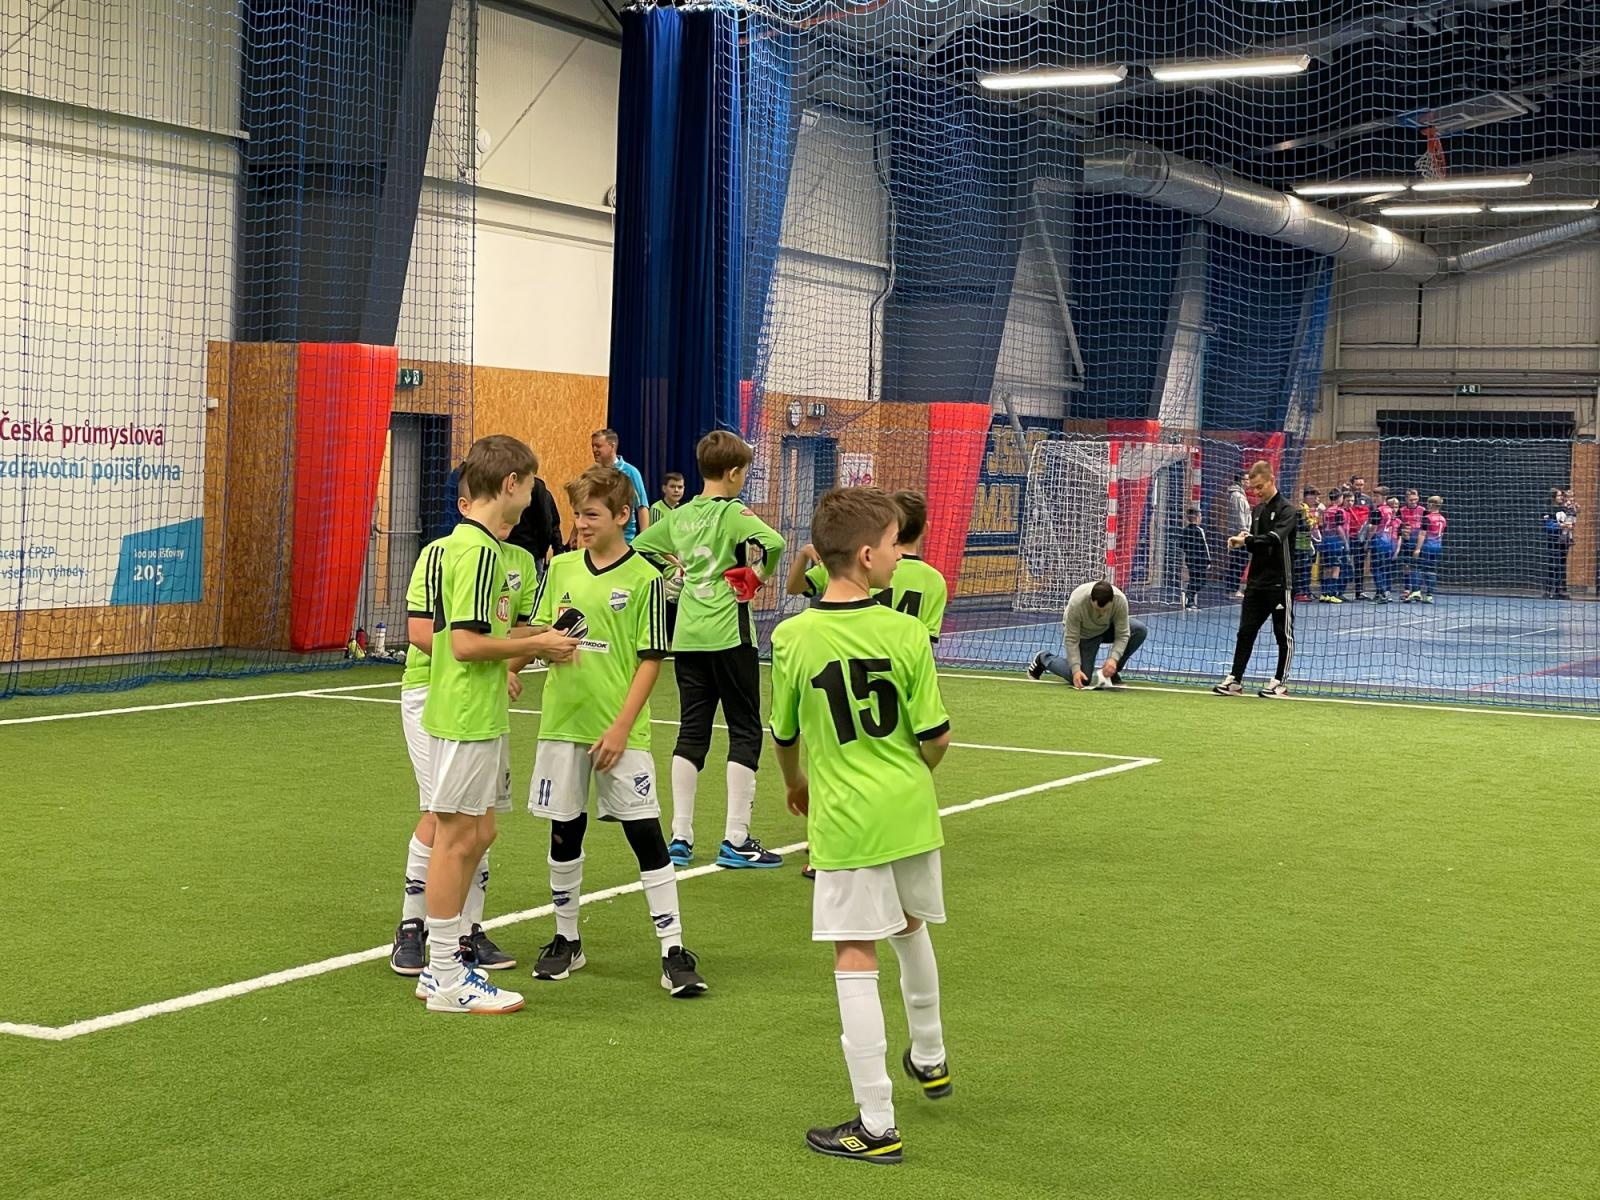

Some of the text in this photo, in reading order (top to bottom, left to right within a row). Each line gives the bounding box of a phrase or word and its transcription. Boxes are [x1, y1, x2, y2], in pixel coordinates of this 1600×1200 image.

[0, 410, 164, 450] Česká průmyslová
[0, 455, 181, 486] zdravotní pojišťovna
[29, 543, 55, 559] ČPZP
[134, 564, 164, 585] 205
[811, 658, 899, 745] 15
